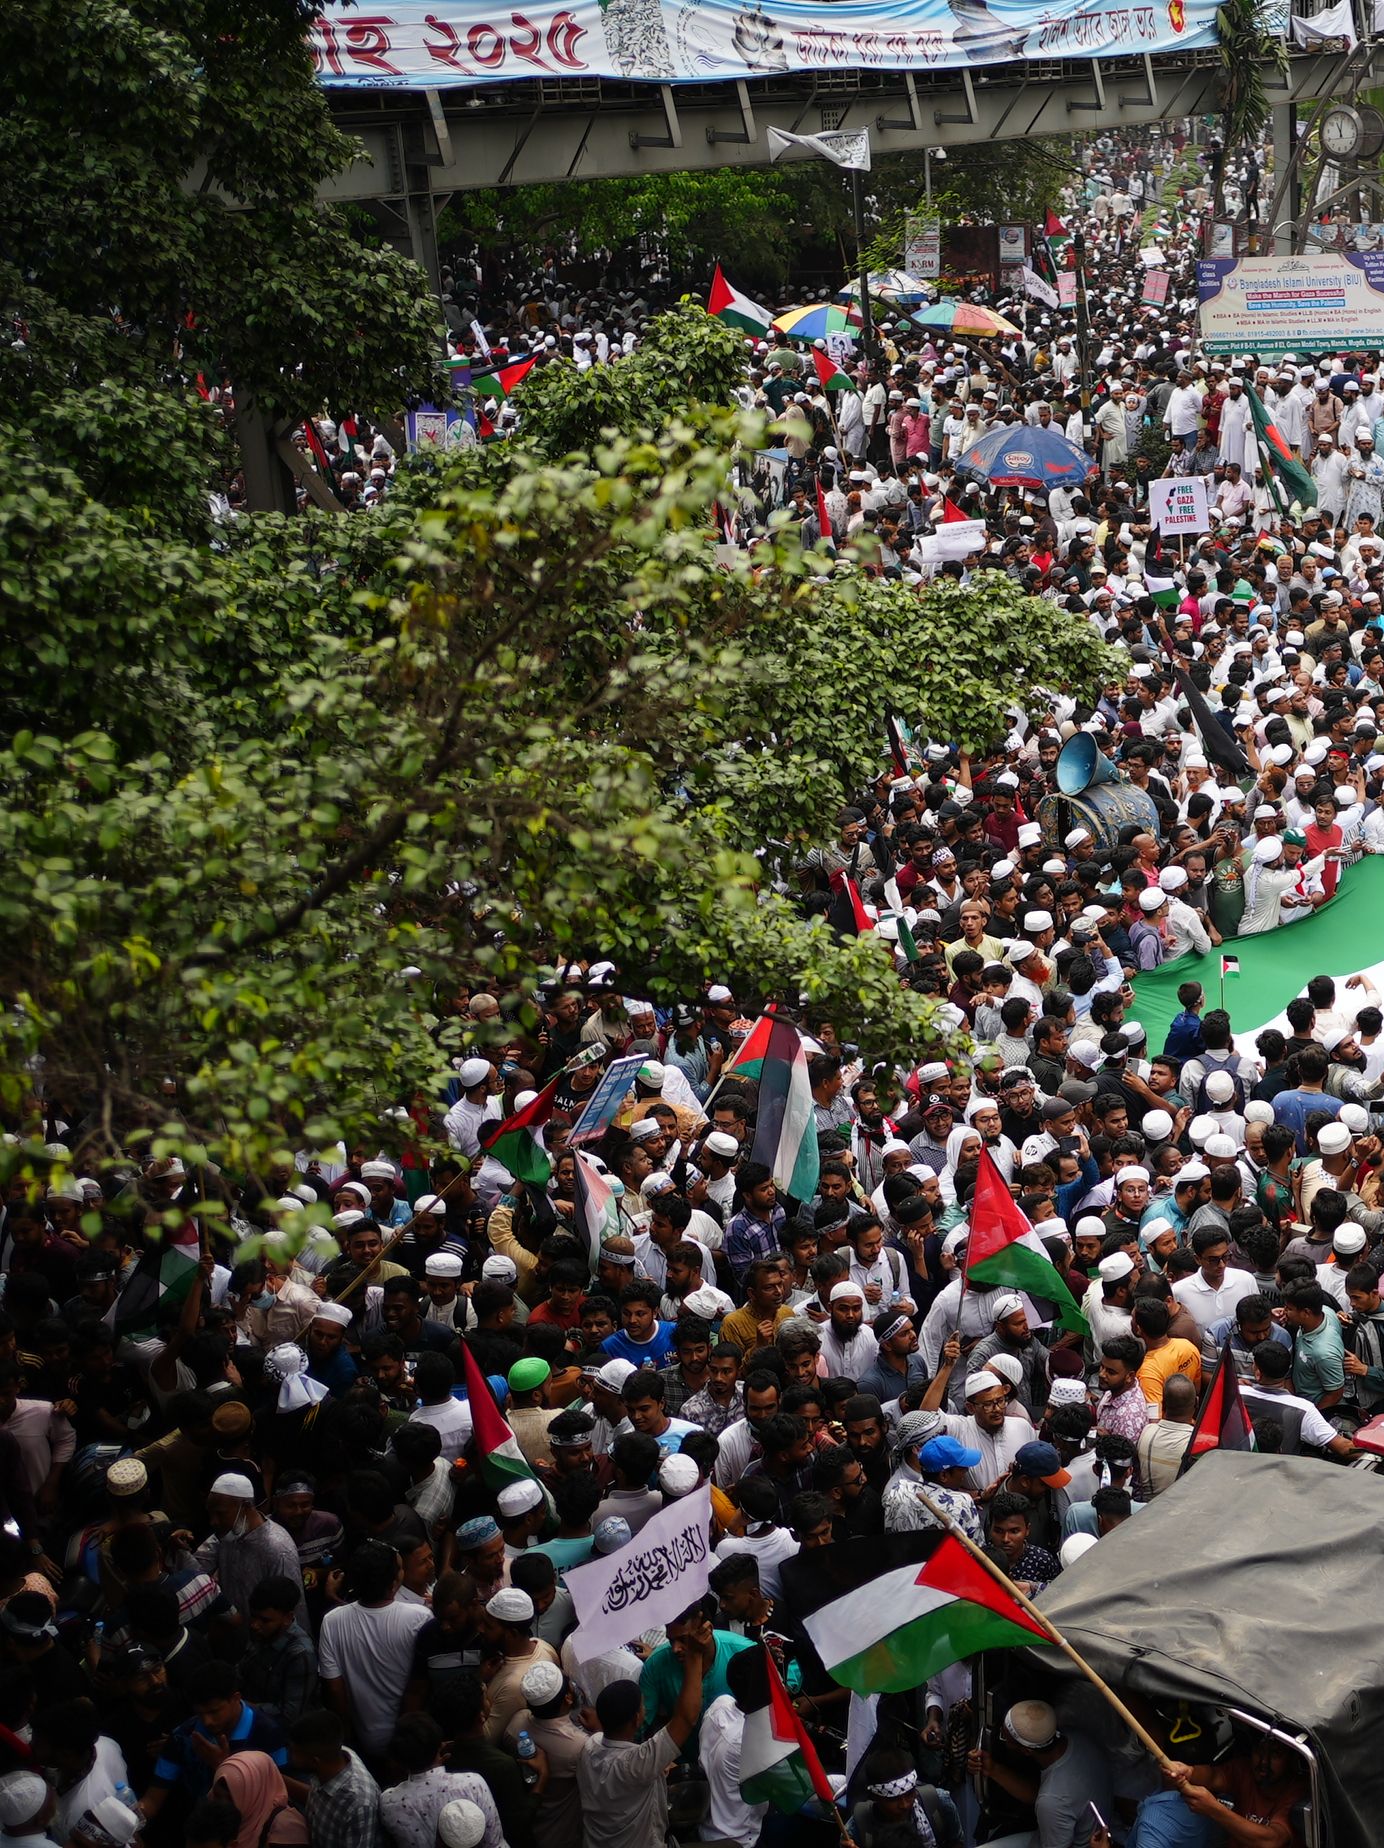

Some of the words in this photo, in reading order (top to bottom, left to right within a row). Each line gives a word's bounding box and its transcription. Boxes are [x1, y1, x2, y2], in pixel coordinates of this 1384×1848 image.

[422, 10, 590, 76] ২০২৫
[1240, 277, 1282, 291] Bangladesh
[1283, 276, 1305, 288] Islami
[1306, 274, 1342, 288] University
[1344, 273, 1363, 287] (BIU)
[1273, 291, 1290, 299] March
[1301, 290, 1316, 298] Gaza
[1007, 455, 1031, 463] Savoy
[1177, 485, 1193, 494] FREE
[1176, 495, 1194, 505] GAZA
[1179, 505, 1195, 514] FREE
[1164, 514, 1197, 524] PALESTINE
